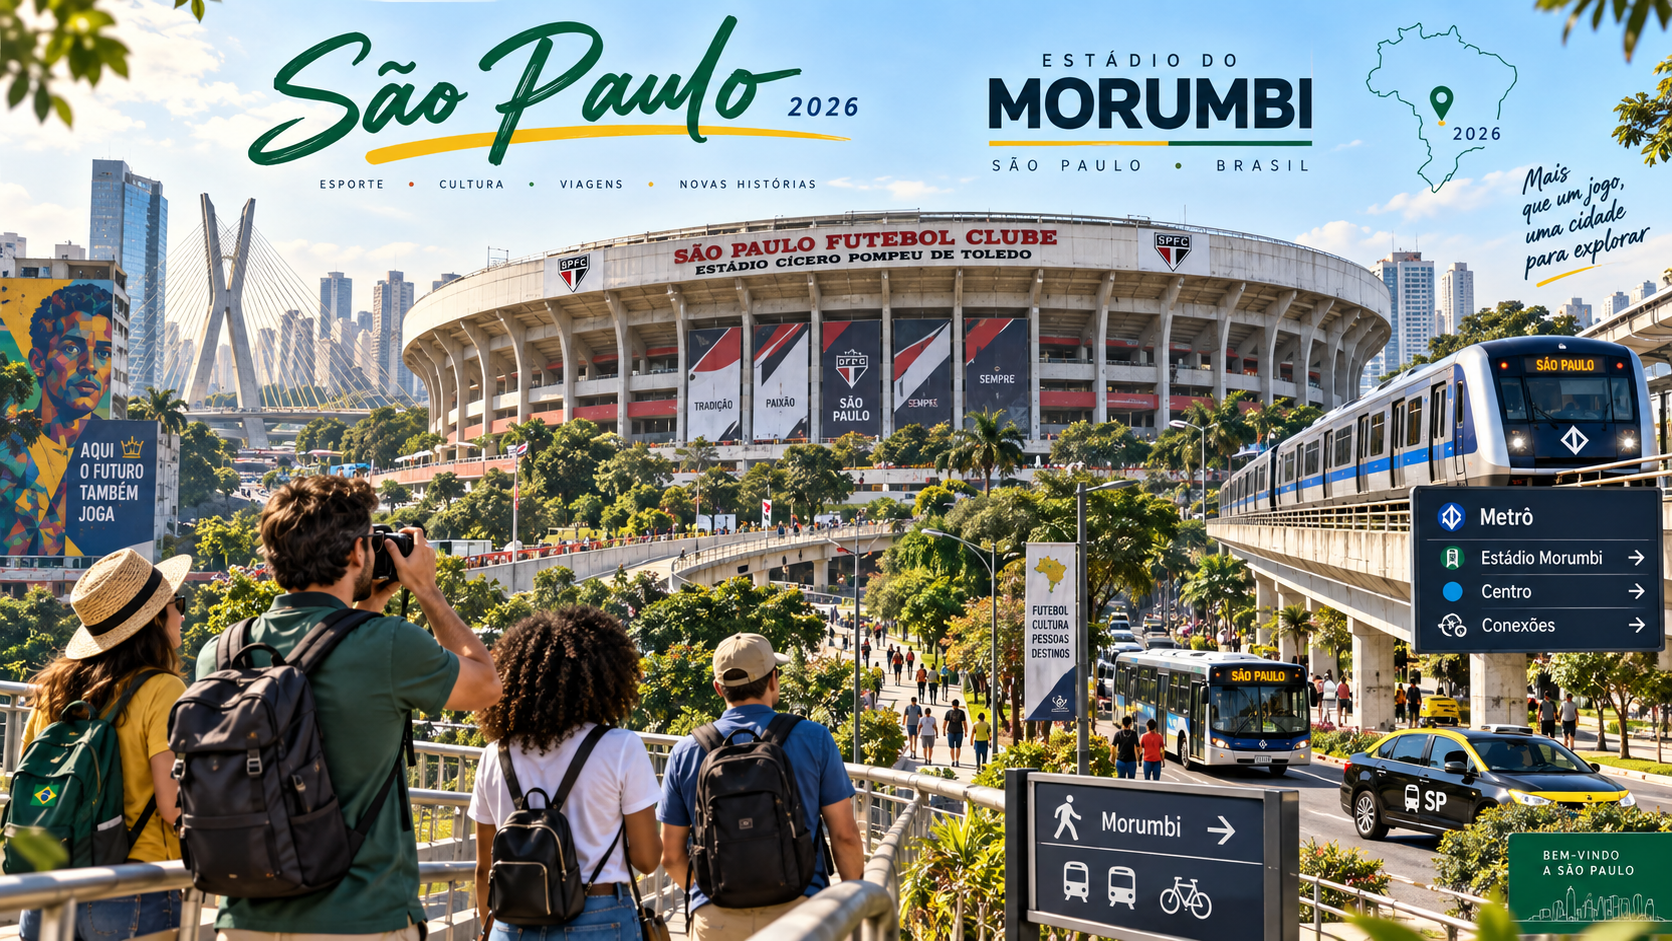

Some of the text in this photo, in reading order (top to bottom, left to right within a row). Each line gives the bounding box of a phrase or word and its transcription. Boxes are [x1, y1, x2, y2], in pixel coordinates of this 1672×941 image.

[675, 230, 1057, 263] SÃO PAULO FUTEBOL CLUBE
[1158, 235, 1188, 246] SPFC
[695, 250, 1031, 276] ESTÁDIO CÍCERO POMPEU DE TOLEDO
[1561, 359, 1594, 371] PAULO
[979, 374, 1016, 384] SEMPRE
[833, 410, 870, 422] PAULO
[81, 443, 113, 460] AQUI
[80, 464, 143, 480] O FUTURO
[80, 481, 138, 500] TAMBÉM
[79, 506, 114, 521] JOGA
[1481, 507, 1533, 525] Metrô
[1482, 550, 1602, 564] Estádio Morumbi
[1482, 584, 1531, 598] Centro
[1033, 606, 1068, 615] FUTEBOL
[1033, 620, 1068, 629] CULTURA
[1483, 618, 1555, 632] Conexões
[1032, 634, 1069, 644] PESSOAS
[1032, 649, 1069, 658] DESTINOS
[1254, 671, 1285, 681] PAULO
[1425, 791, 1447, 811] SP
[1103, 812, 1180, 837] Morumbi
[1544, 851, 1619, 860] BEM-VINDO
[1543, 864, 1633, 875] A SÃO PAULO
